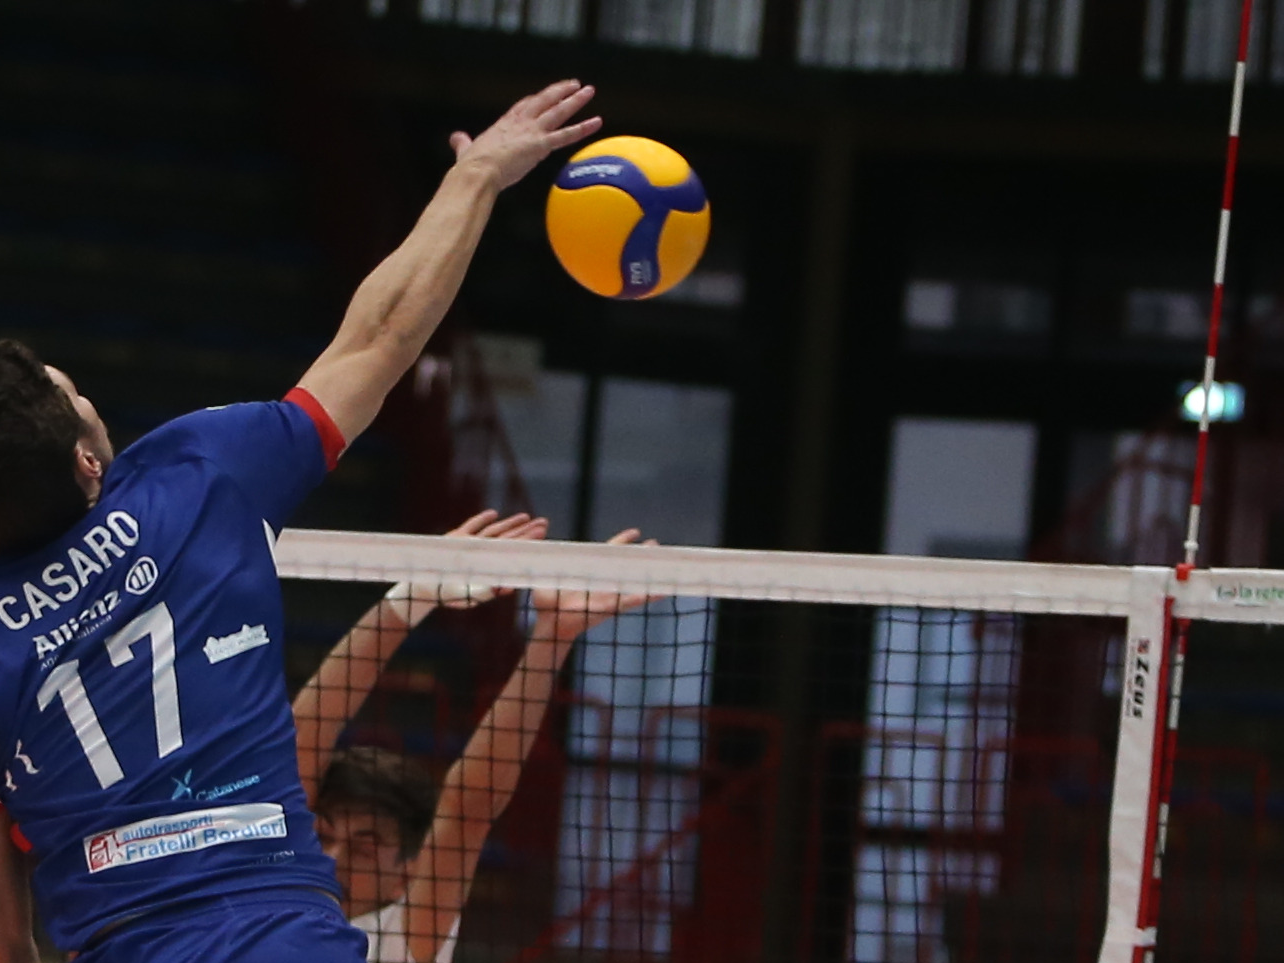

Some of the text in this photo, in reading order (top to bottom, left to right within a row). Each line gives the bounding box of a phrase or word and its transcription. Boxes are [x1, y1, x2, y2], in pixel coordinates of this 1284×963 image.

[37, 601, 184, 791] 17
[1133, 658, 1149, 719] Zeus
[122, 813, 214, 842] autotrasporti
[125, 816, 286, 862] Fratelli Bordieri
